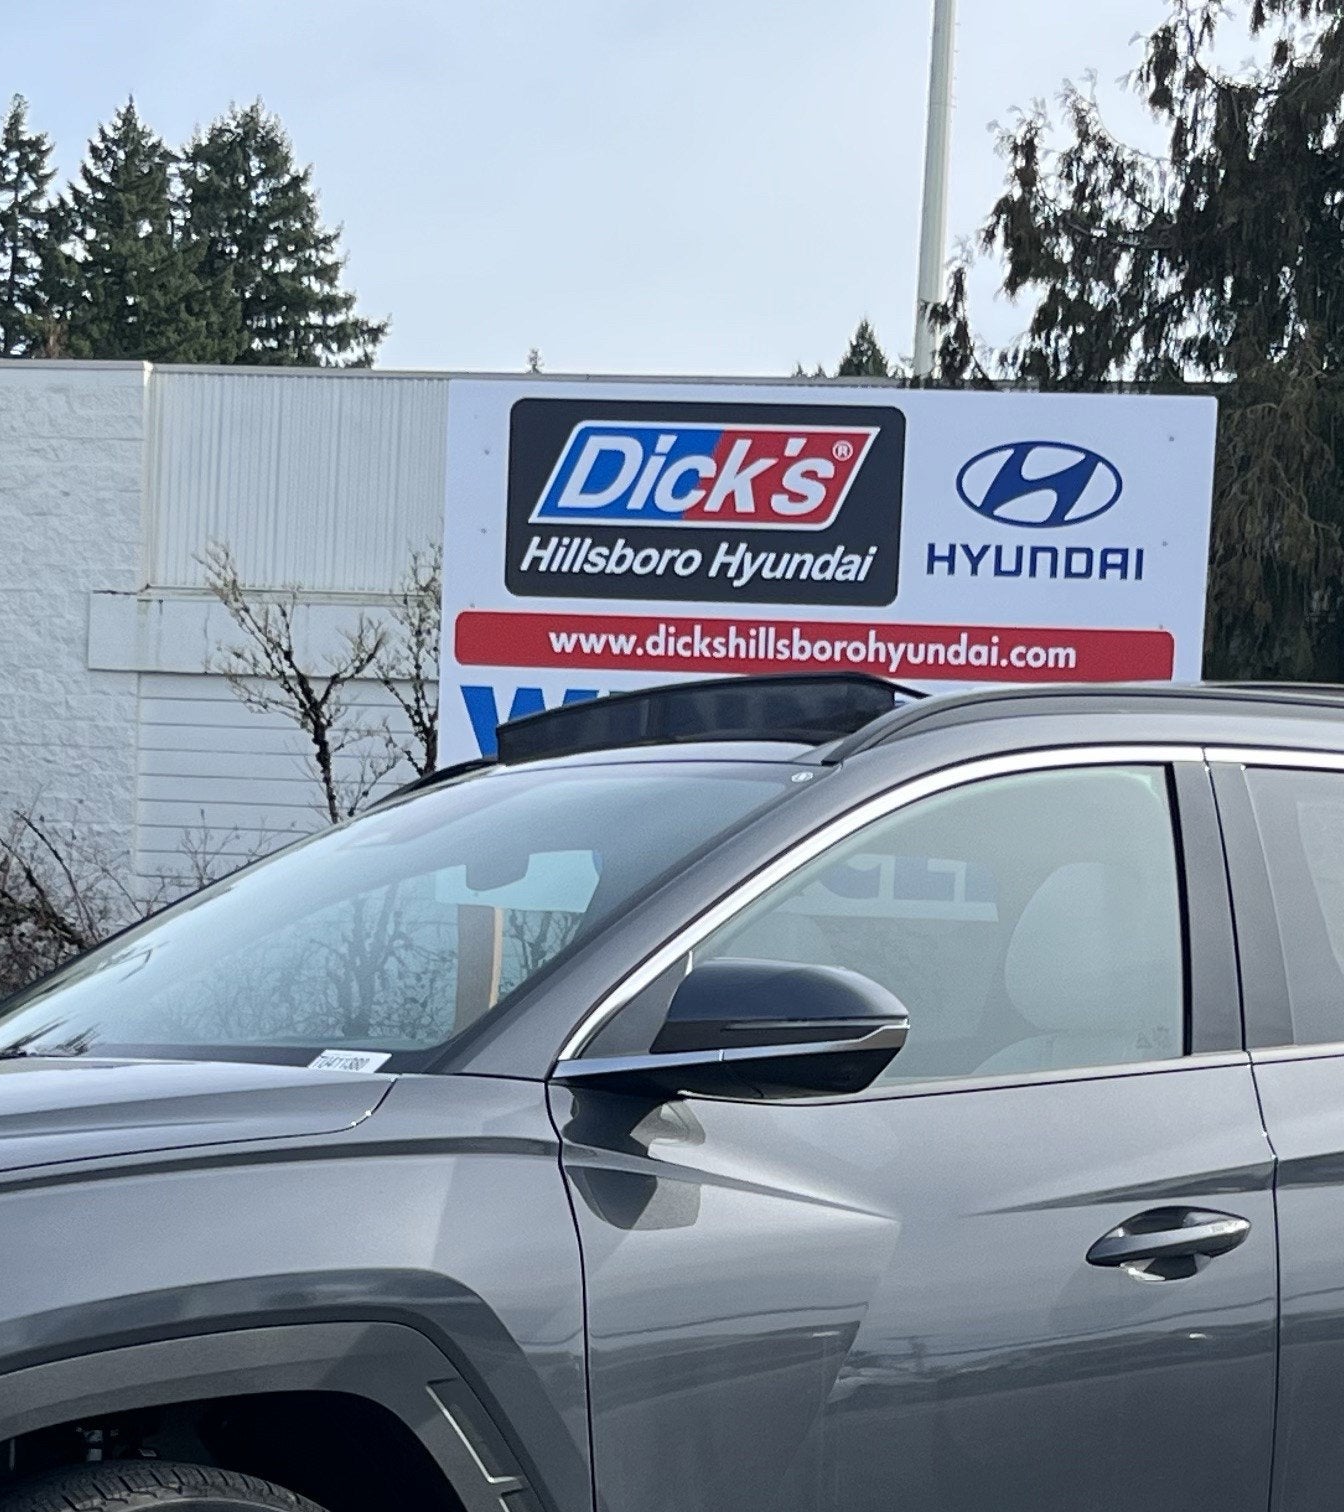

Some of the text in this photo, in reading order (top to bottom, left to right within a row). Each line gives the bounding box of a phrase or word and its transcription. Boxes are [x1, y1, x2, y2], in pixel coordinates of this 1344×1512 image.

[557, 434, 835, 516] Dick's
[520, 536, 878, 588] Hillsboro Hyundai
[926, 543, 1144, 580] HYUNDAI
[549, 623, 1076, 672] www.dickshillsborohyundai.com
